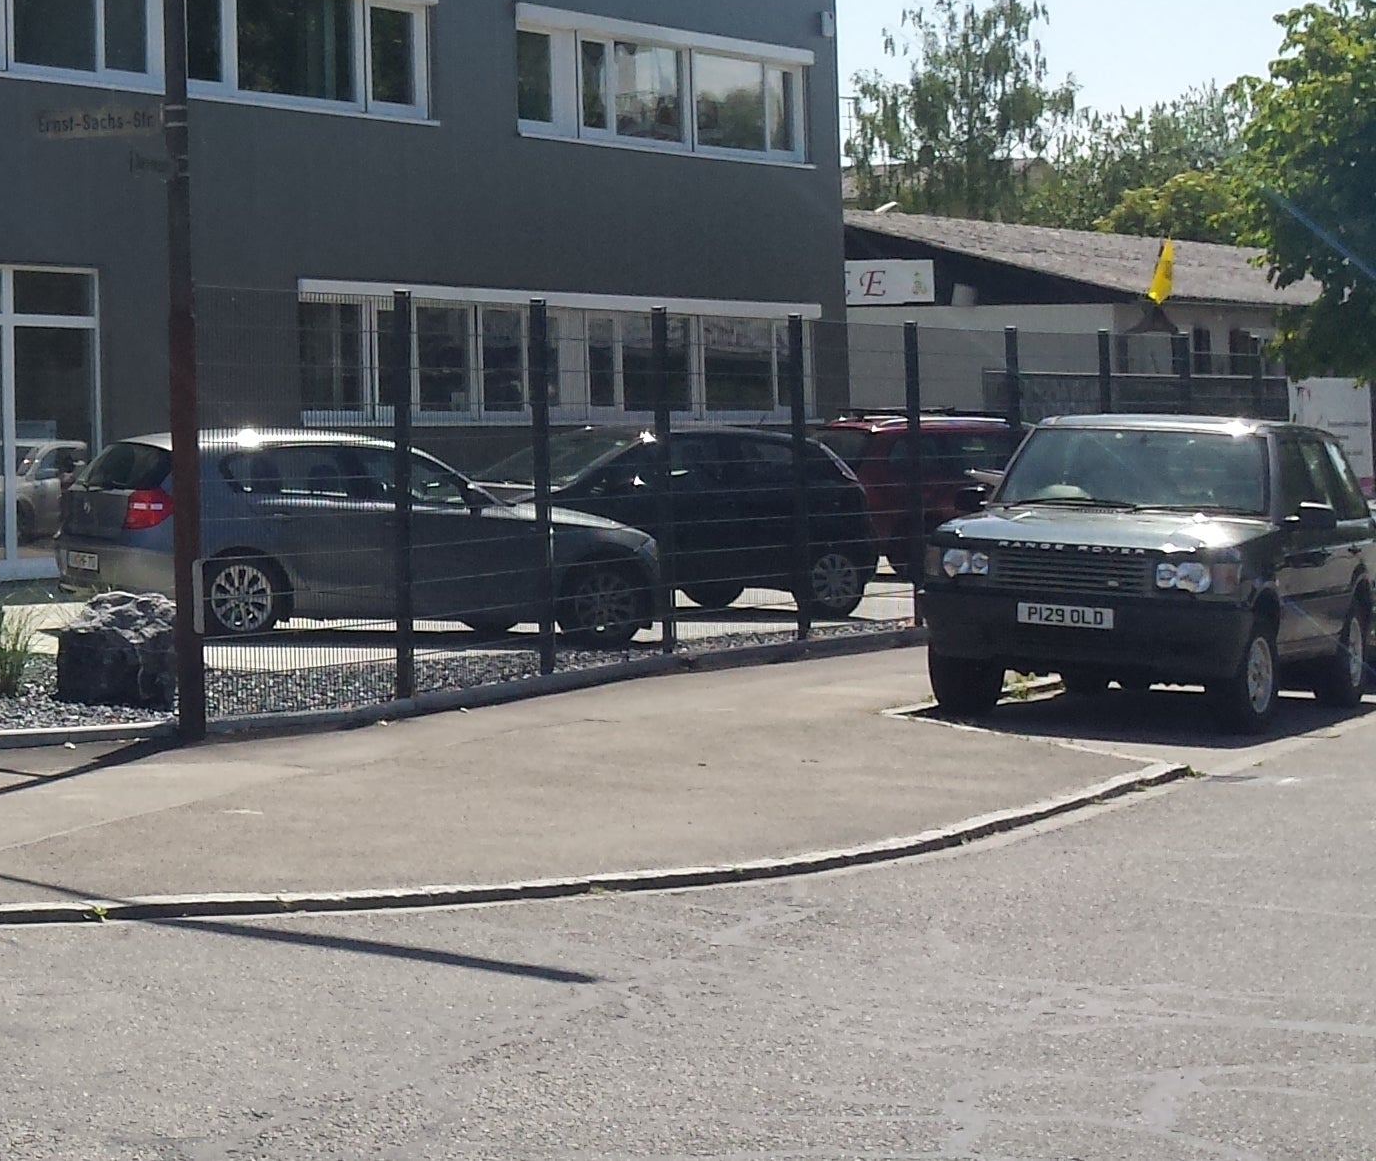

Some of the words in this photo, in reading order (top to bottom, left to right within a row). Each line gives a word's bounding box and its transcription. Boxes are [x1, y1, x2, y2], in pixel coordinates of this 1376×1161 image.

[999, 540, 1064, 551] RANGE
[1077, 545, 1145, 555] ROVER
[1028, 606, 1065, 623] P129
[1071, 609, 1103, 625] OLD
